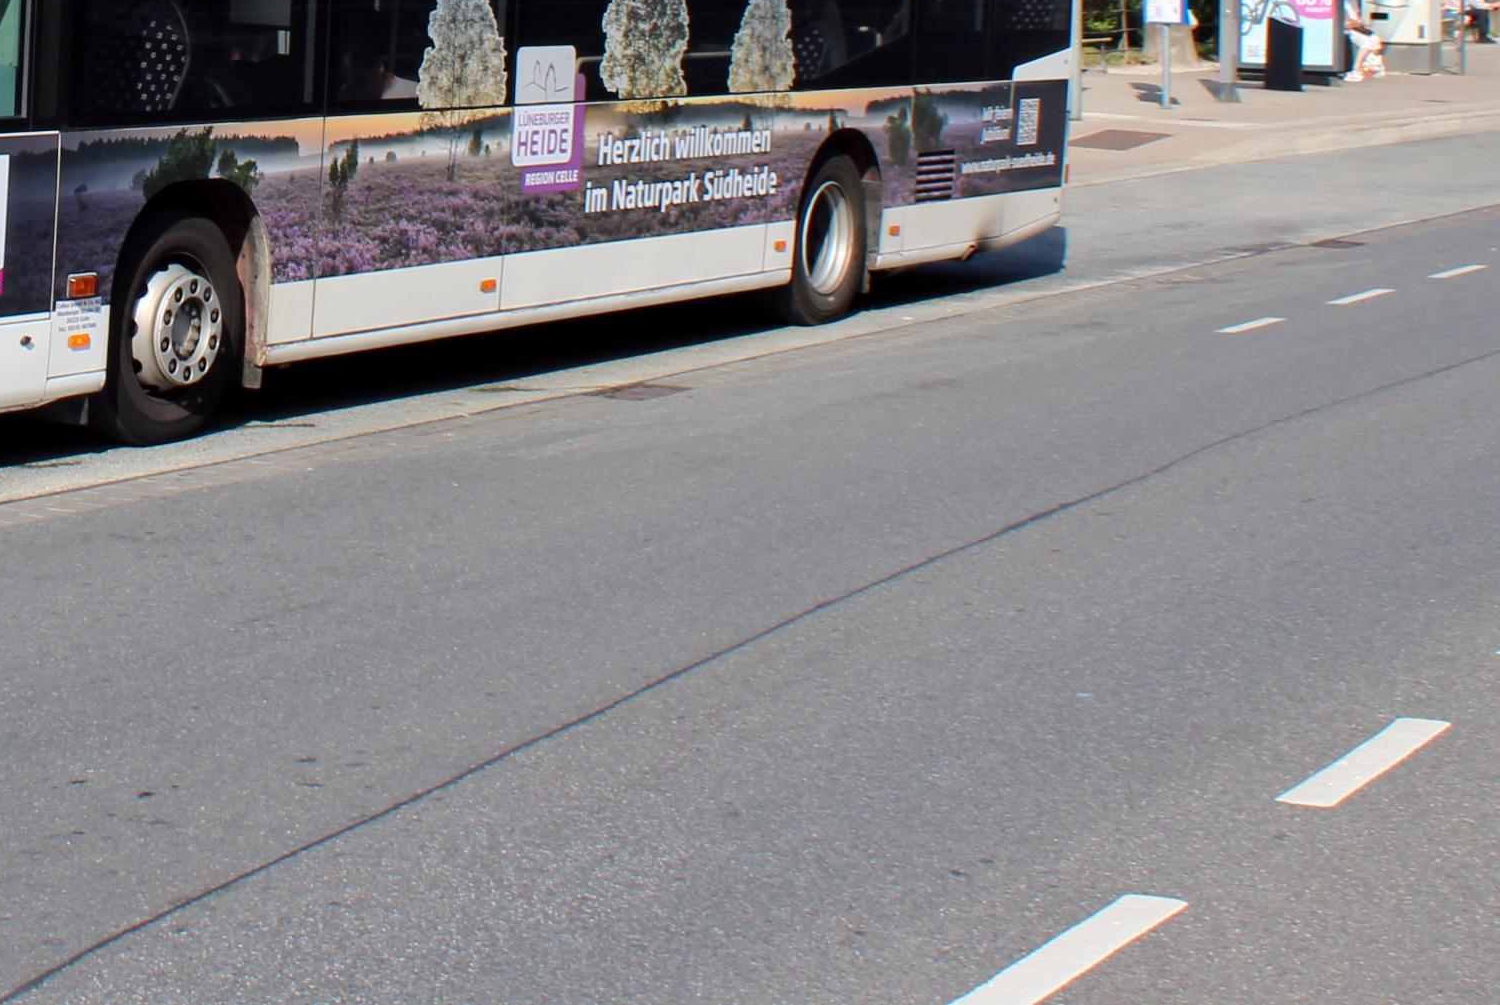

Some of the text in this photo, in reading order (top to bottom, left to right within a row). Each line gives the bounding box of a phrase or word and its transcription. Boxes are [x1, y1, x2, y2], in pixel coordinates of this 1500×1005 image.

[518, 111, 570, 127] LÜNEBURGER
[516, 128, 570, 158] HEIDE
[597, 126, 772, 165] Herzlich willkommen
[524, 169, 579, 187] REGION CELLE
[584, 165, 778, 213] im Naturpark Südheide
